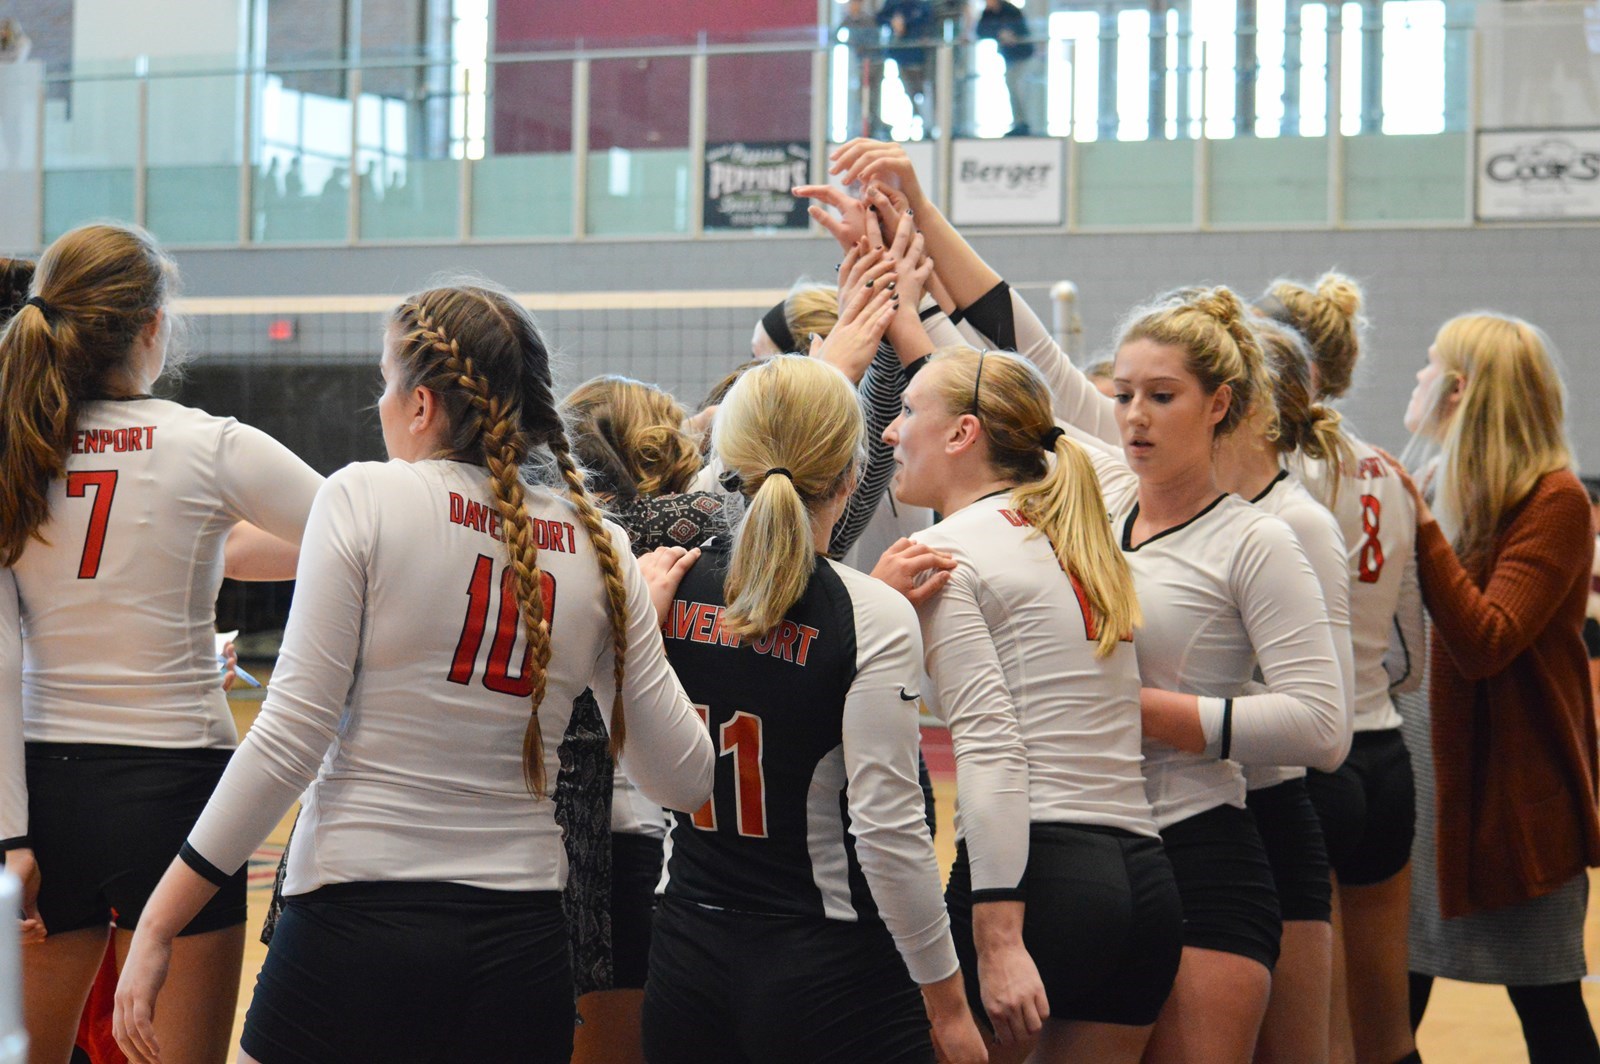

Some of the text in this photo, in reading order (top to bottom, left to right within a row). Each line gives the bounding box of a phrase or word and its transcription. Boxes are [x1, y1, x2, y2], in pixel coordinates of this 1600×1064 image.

[960, 158, 1052, 190] Berger
[72, 426, 158, 454] ENPORT
[66, 470, 118, 579] 7
[449, 491, 576, 554] DAVEORT
[1358, 494, 1384, 584] 8
[447, 553, 556, 697] 10
[662, 600, 819, 666] AVENORT
